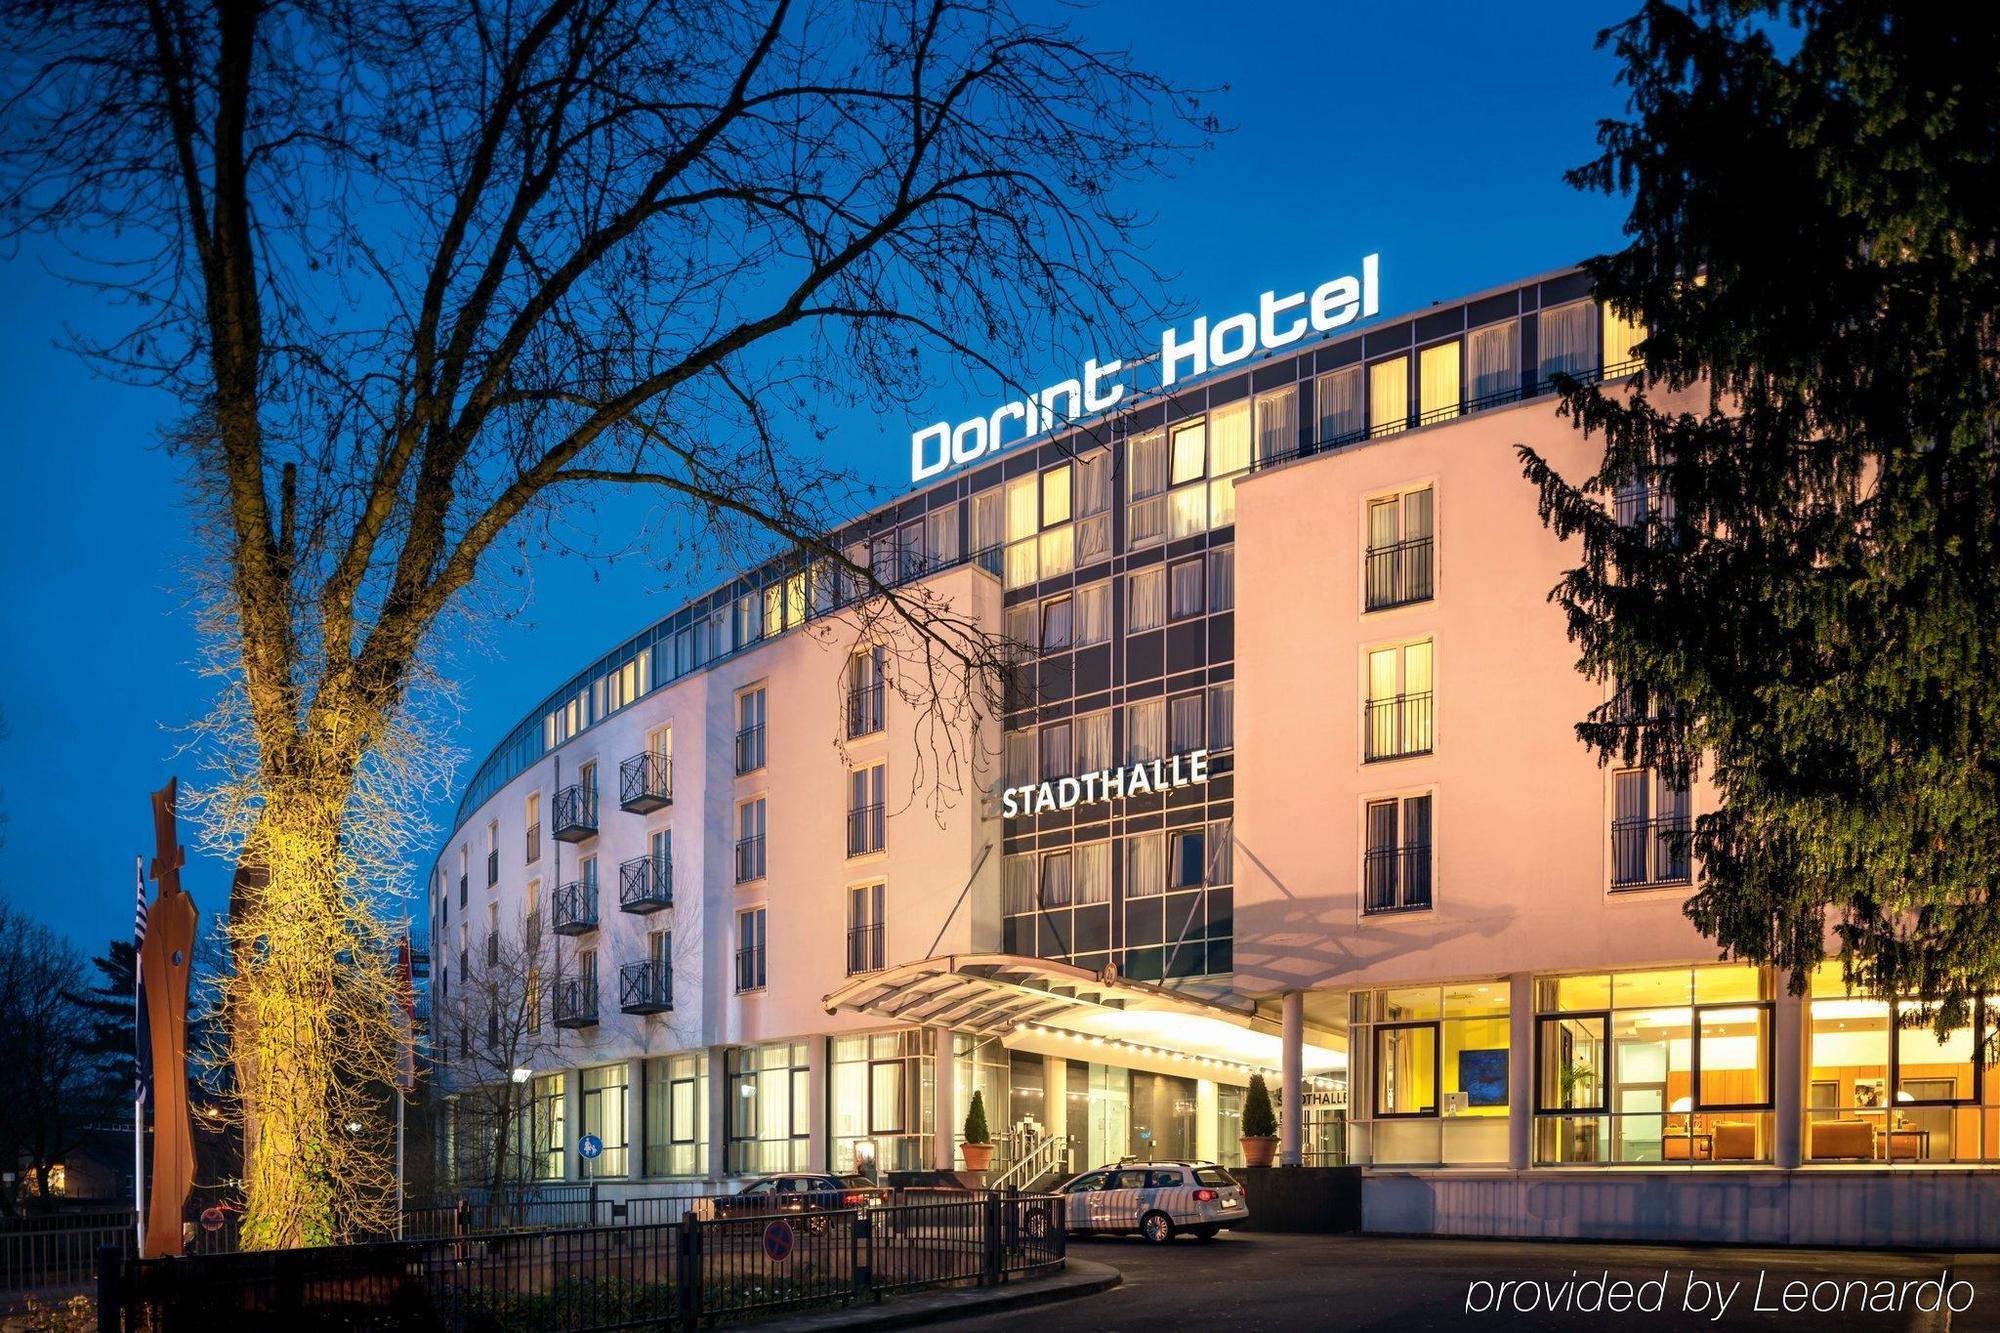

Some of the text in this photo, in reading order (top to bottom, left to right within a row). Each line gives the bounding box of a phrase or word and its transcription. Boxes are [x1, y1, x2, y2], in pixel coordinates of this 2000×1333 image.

[912, 253, 1379, 483] Dorint Hotel
[1002, 749, 1208, 819] STADTHALLE
